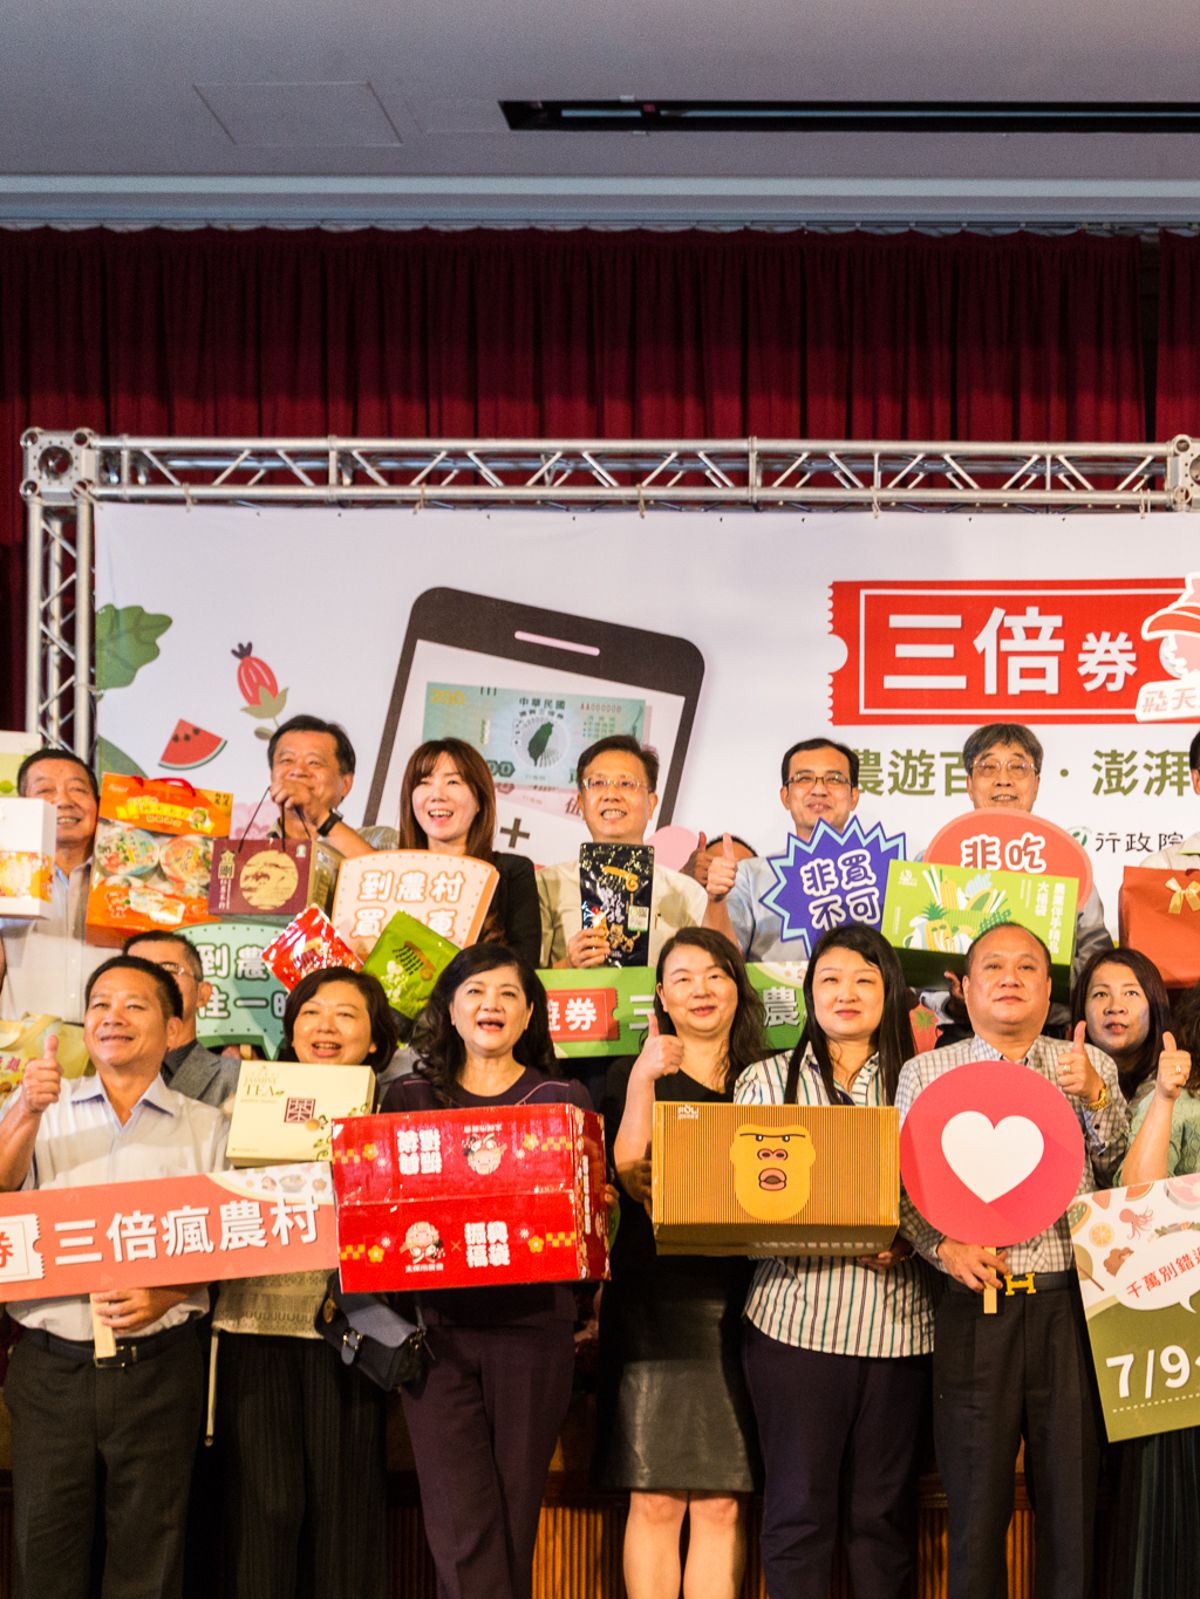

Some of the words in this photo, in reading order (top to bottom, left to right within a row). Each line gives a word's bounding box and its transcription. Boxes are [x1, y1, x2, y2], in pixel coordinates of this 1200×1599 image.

[883, 606, 1137, 695] 三倍券
[800, 849, 877, 897] 非買
[961, 832, 1047, 874] 非吃
[357, 869, 466, 904] 到農村
[808, 886, 881, 931] 不可
[350, 906, 457, 939] 買車
[53, 1194, 320, 1266] 三倍瘋農村
